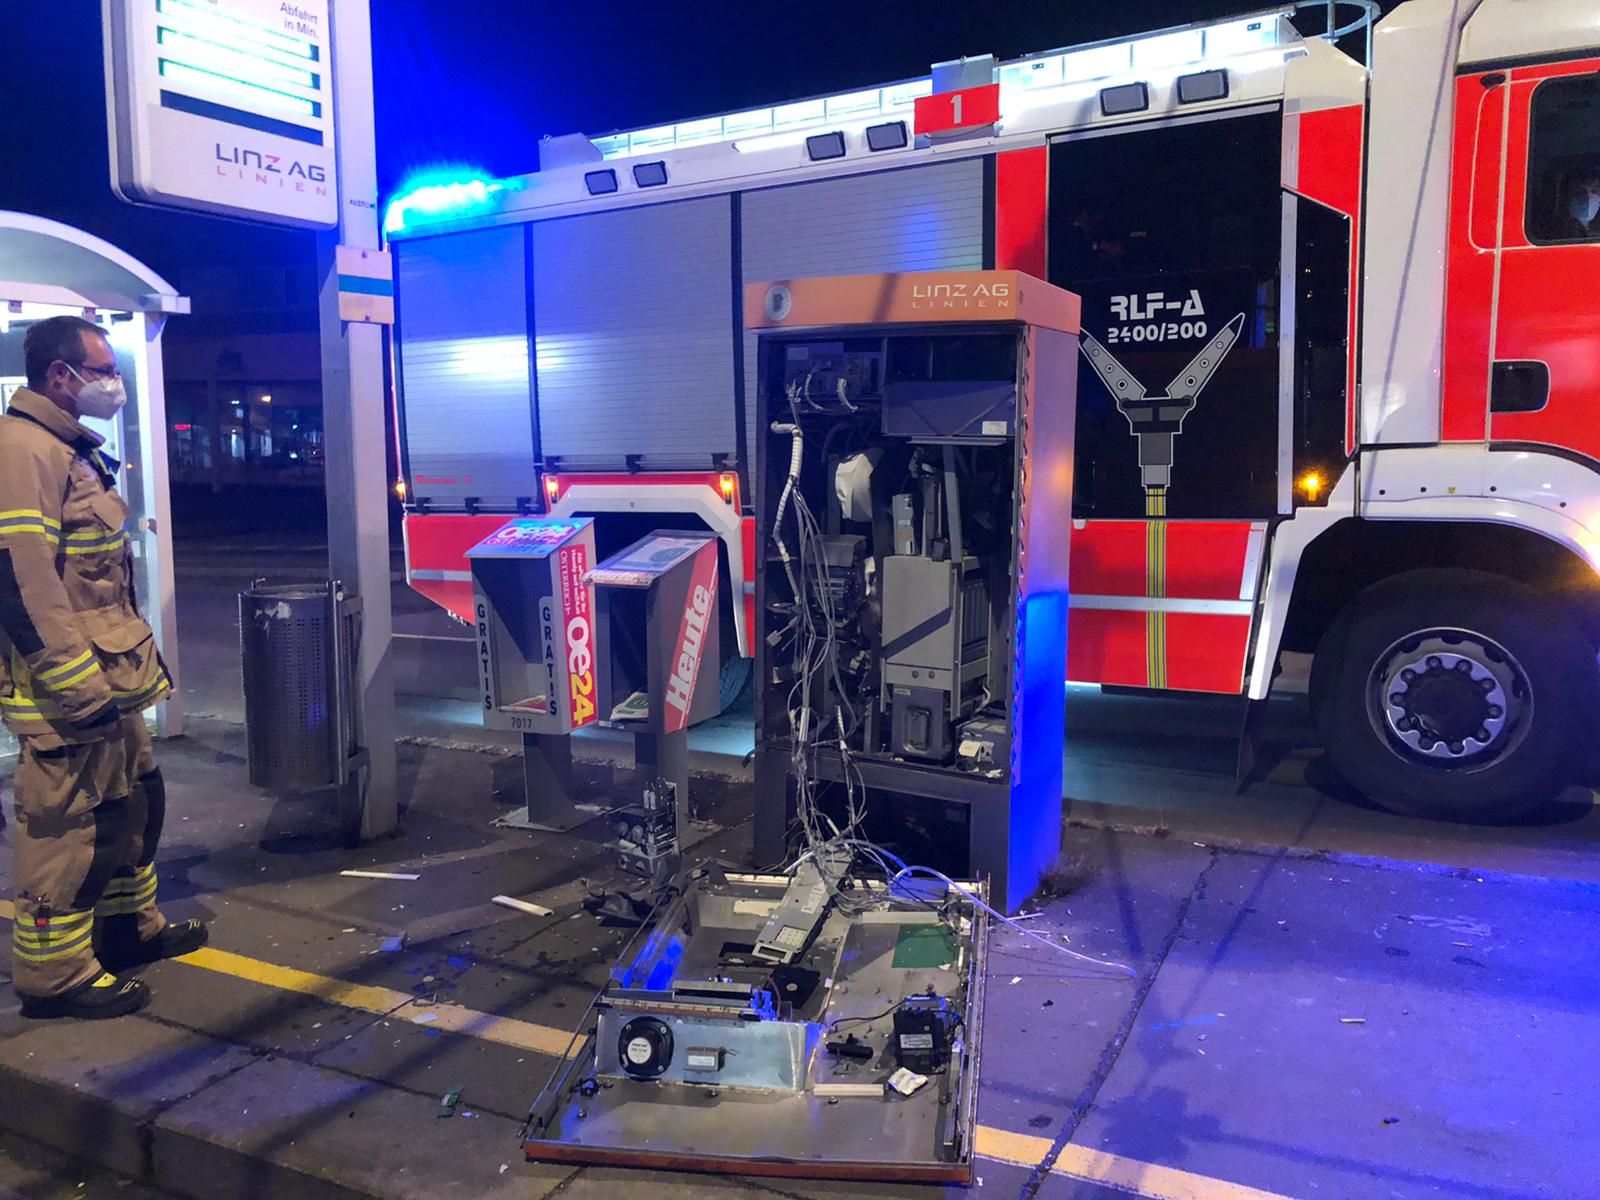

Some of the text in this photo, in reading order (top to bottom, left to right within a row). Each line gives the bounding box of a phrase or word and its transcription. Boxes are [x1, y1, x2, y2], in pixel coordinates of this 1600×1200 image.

[280, 2, 319, 25] Abfahrt
[284, 19, 319, 39] in Min.
[950, 94, 963, 125] 1
[216, 143, 326, 183] LINZ AG
[216, 165, 327, 197] LINIEN
[912, 283, 1009, 299] LINZ AG
[912, 299, 1009, 309] LINIEN
[1110, 289, 1206, 321] RLF-A
[1107, 321, 1208, 344] 2400/200
[477, 604, 492, 710] GRATIS
[543, 606, 557, 715] GRATIS
[666, 584, 711, 713] Heute
[511, 717, 532, 729] 7017
